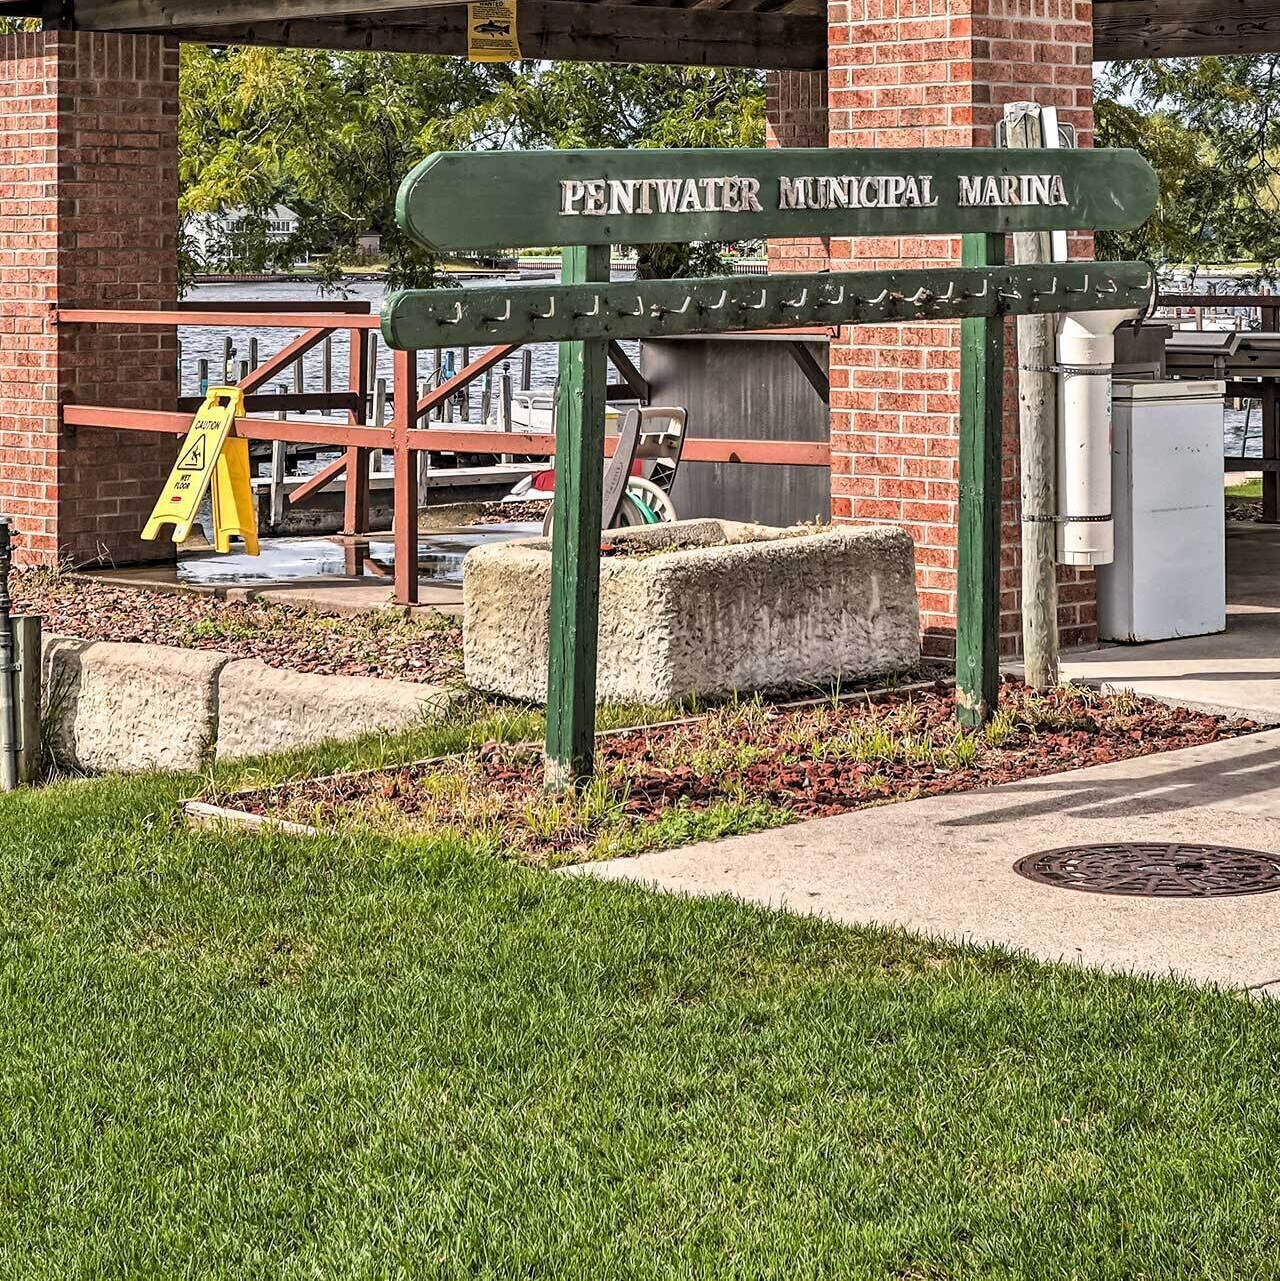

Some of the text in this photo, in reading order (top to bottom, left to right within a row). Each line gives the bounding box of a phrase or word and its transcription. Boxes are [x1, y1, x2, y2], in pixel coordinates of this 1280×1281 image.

[559, 174, 1069, 217] PENTWATER MUNICIPAL MARINA
[195, 421, 221, 430] CAUTION
